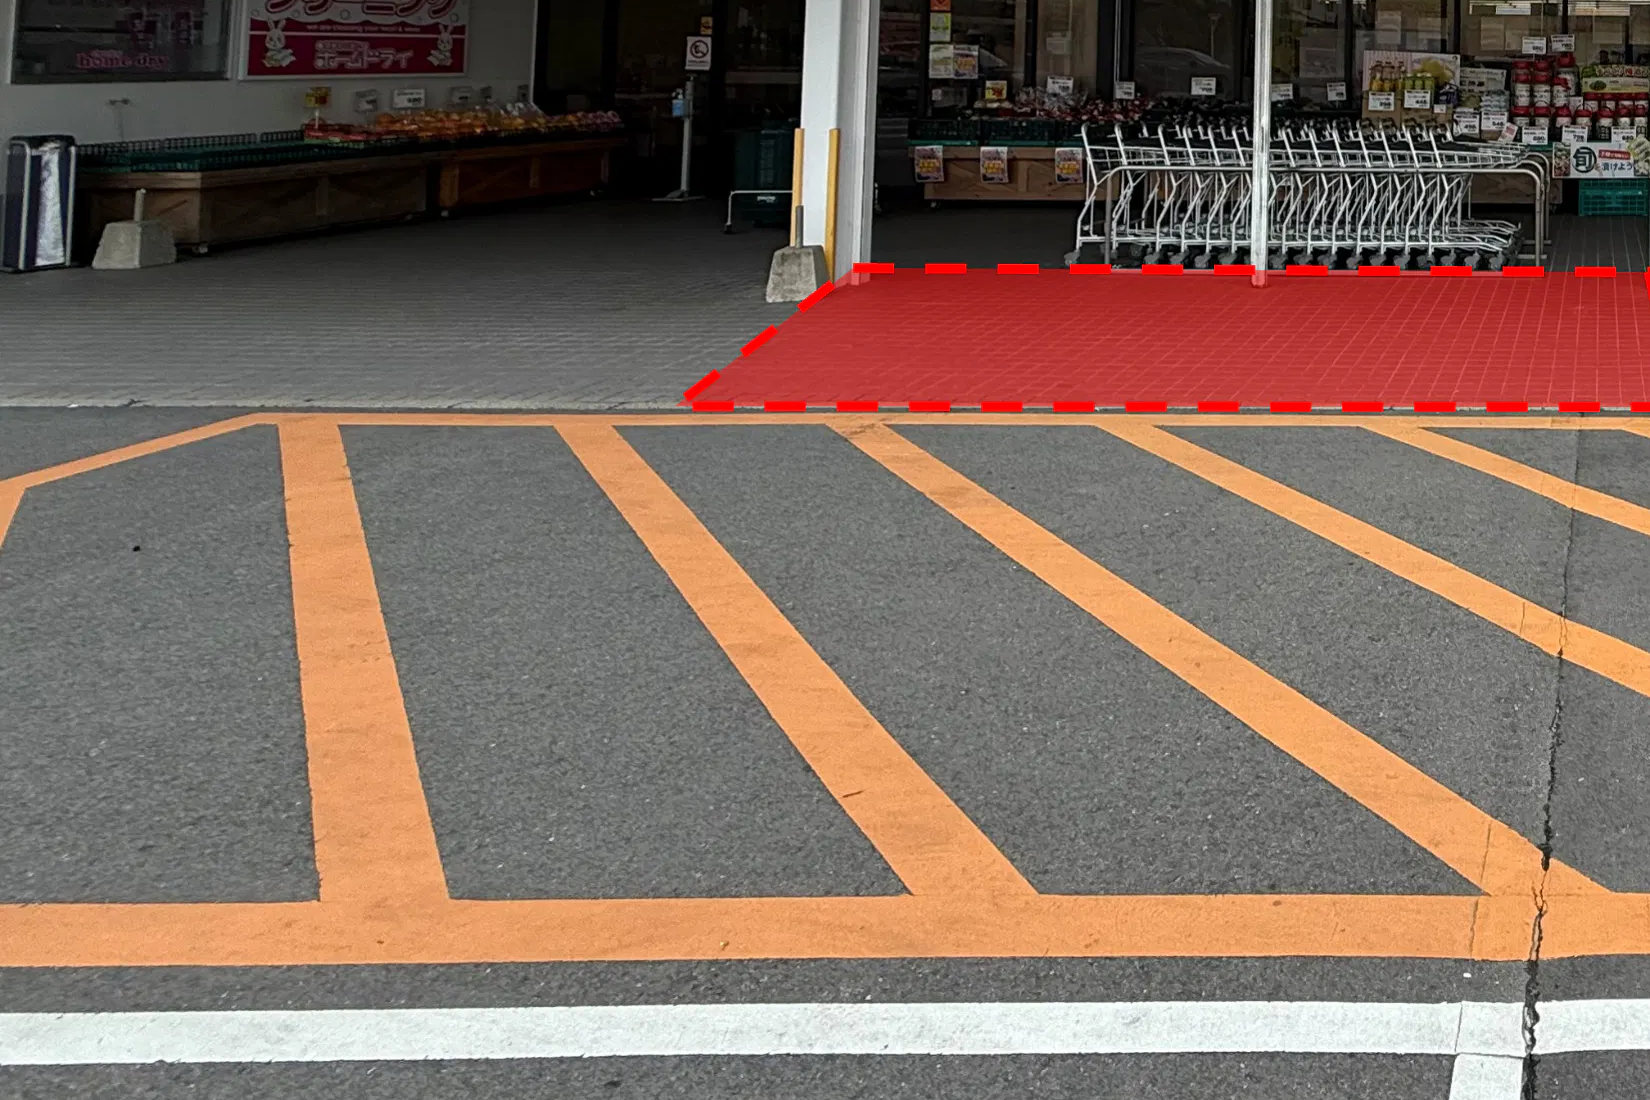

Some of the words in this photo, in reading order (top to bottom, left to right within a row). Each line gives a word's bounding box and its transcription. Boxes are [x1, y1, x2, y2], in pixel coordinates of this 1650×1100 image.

[314, 48, 414, 69] ホームドライ
